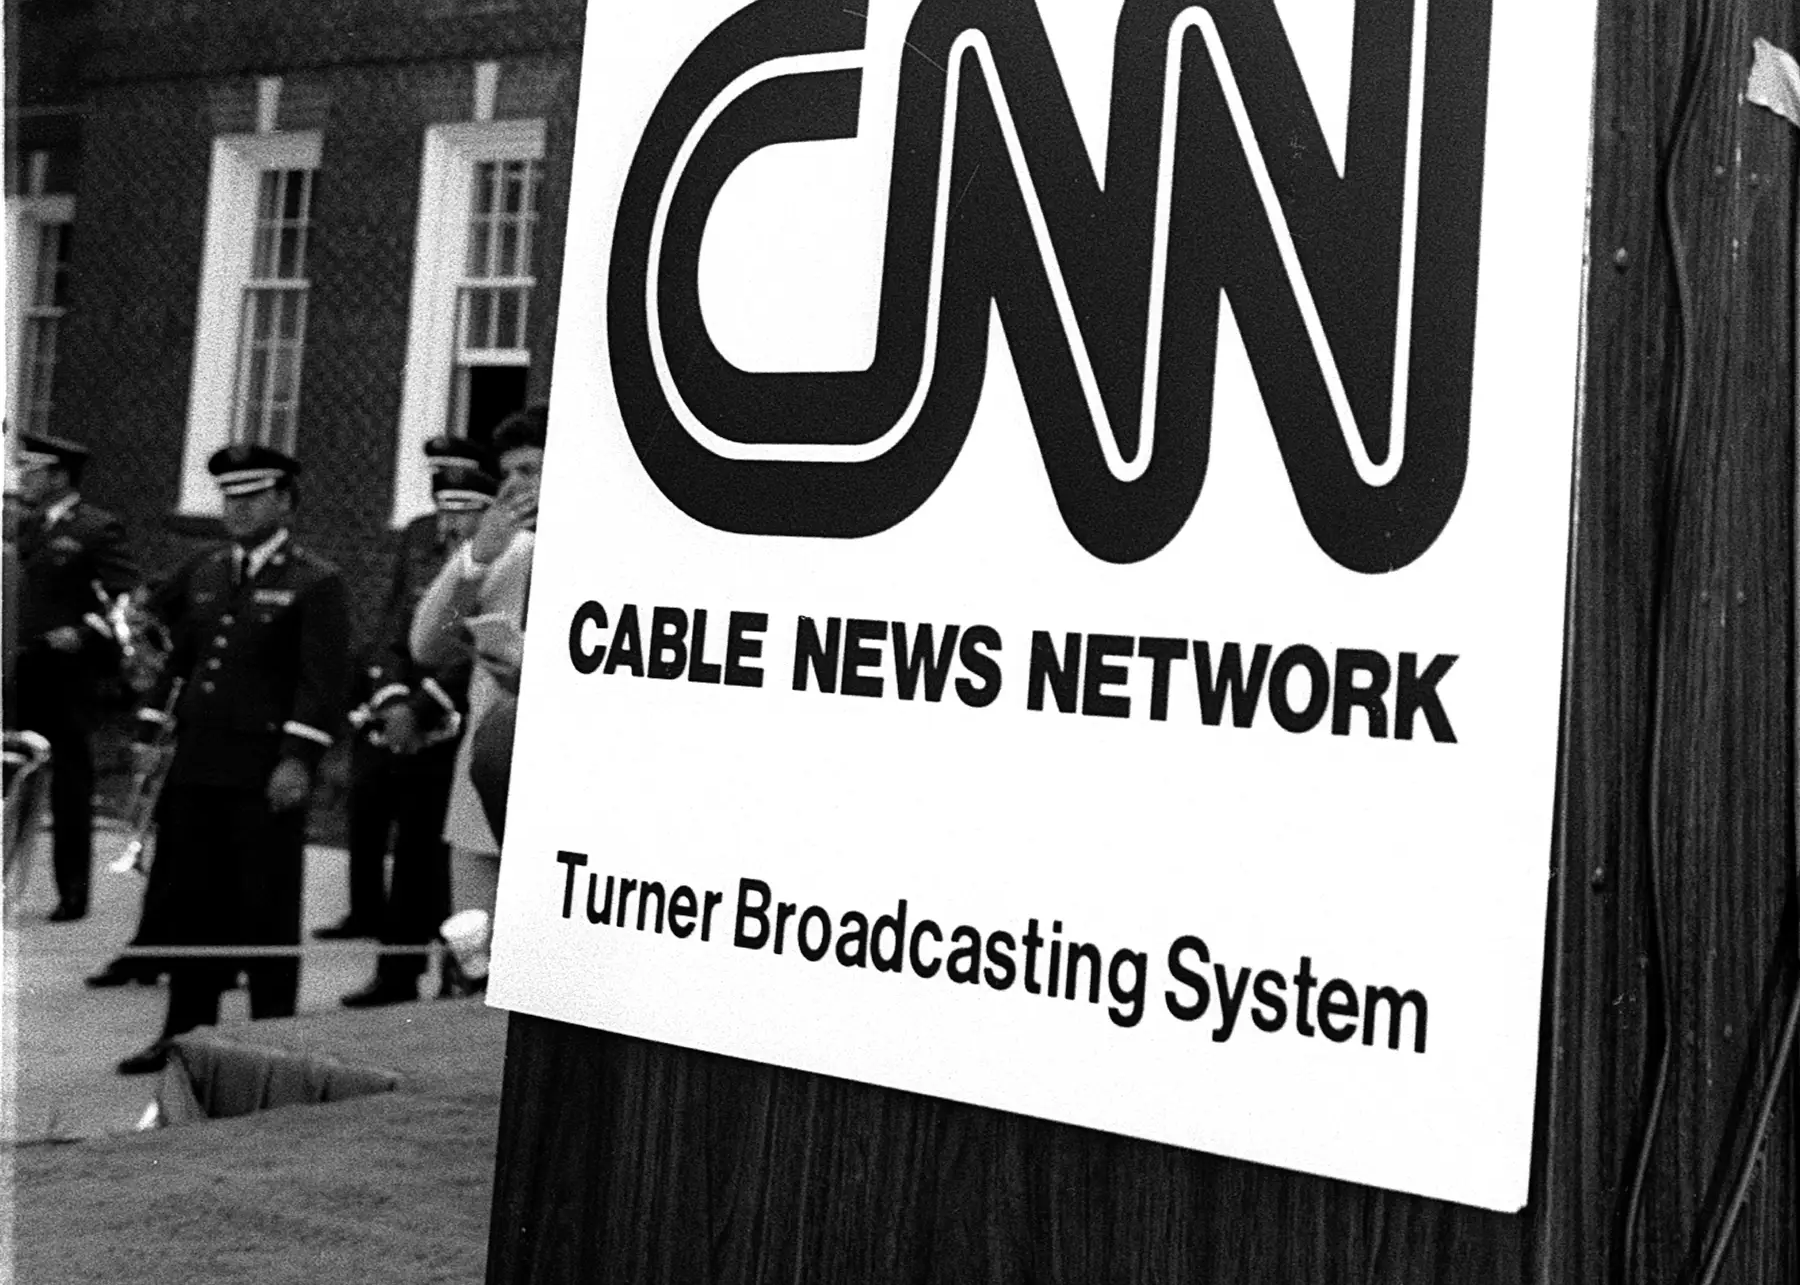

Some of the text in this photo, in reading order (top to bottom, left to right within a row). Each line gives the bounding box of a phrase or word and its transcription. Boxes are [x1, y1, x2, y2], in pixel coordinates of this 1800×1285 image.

[568, 600, 1460, 744] CABLE NEWS NETWORK
[556, 850, 1428, 1054] Turner Broadcasting System
